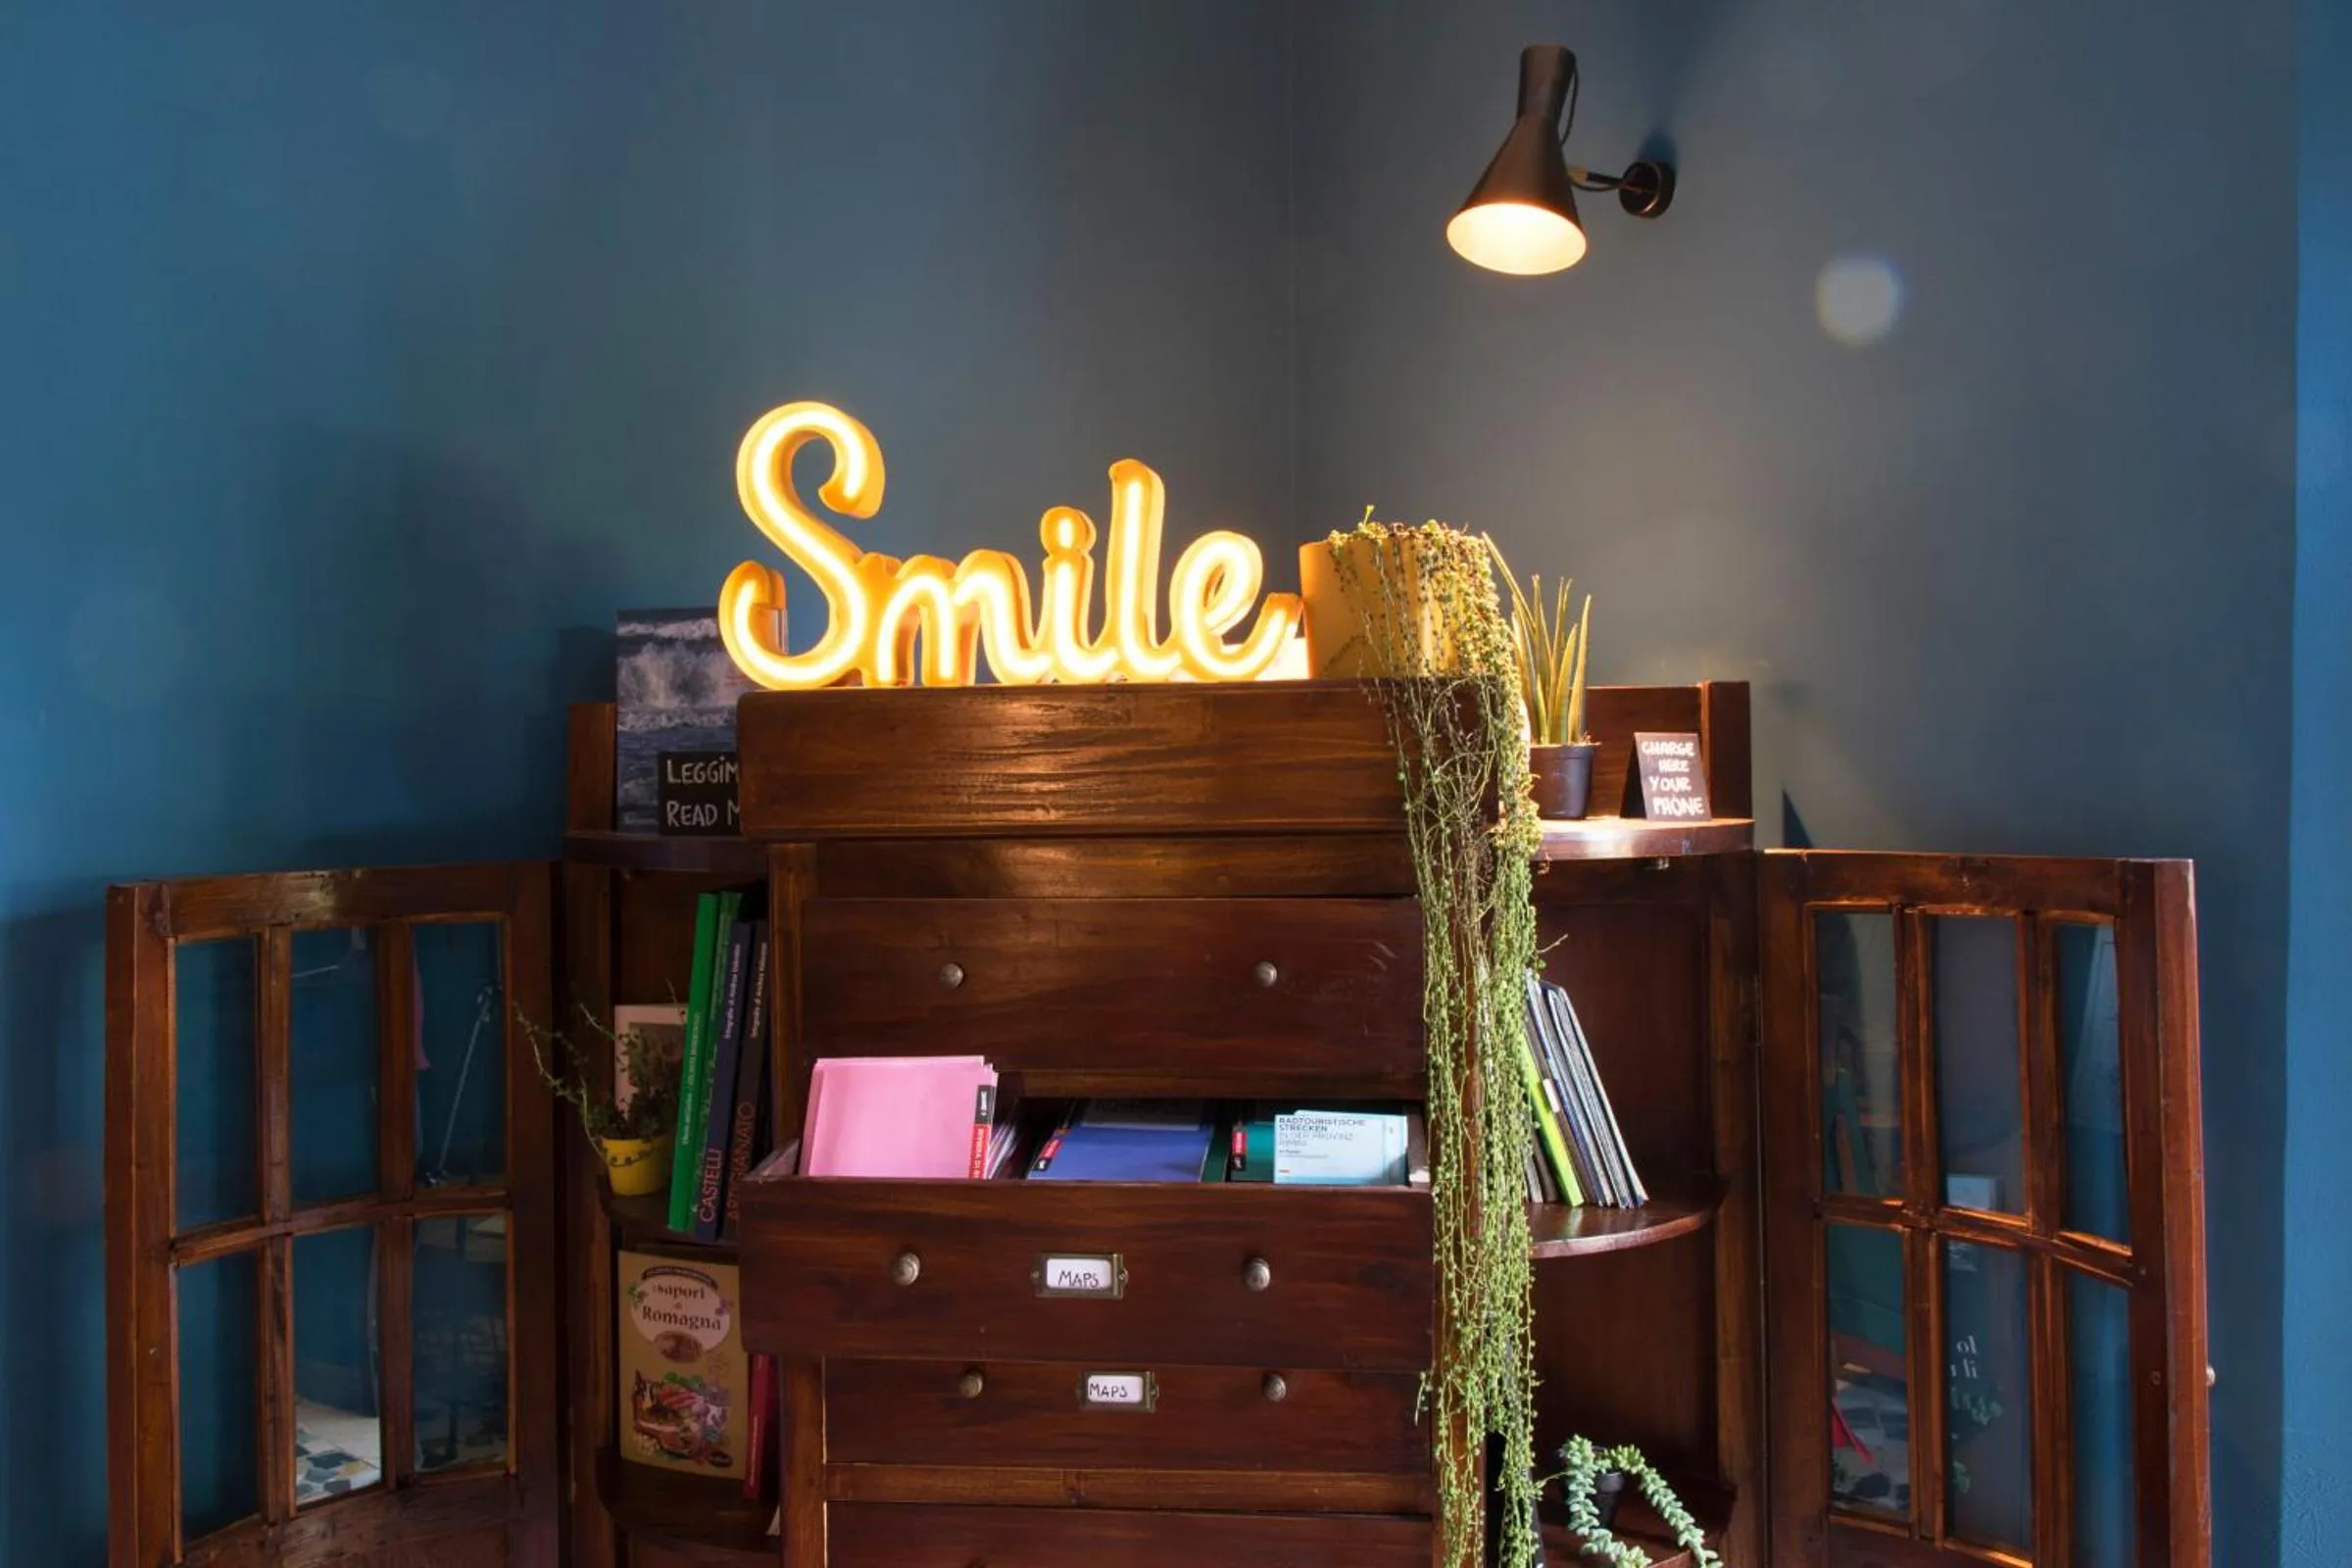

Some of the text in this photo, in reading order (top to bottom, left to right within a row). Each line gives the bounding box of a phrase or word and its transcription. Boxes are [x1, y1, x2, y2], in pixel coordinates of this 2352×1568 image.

[719, 401, 1303, 690] Smile
[1642, 741, 1694, 757] CHARGE
[1648, 775, 1691, 792] YOUR
[666, 800, 718, 827] READ
[1652, 796, 1705, 817] PHONE
[700, 1149, 722, 1222] CASTELLI
[1058, 1270, 1099, 1289] MAPS
[642, 1304, 721, 1330] Romagna
[1089, 1383, 1128, 1397] MAPS
